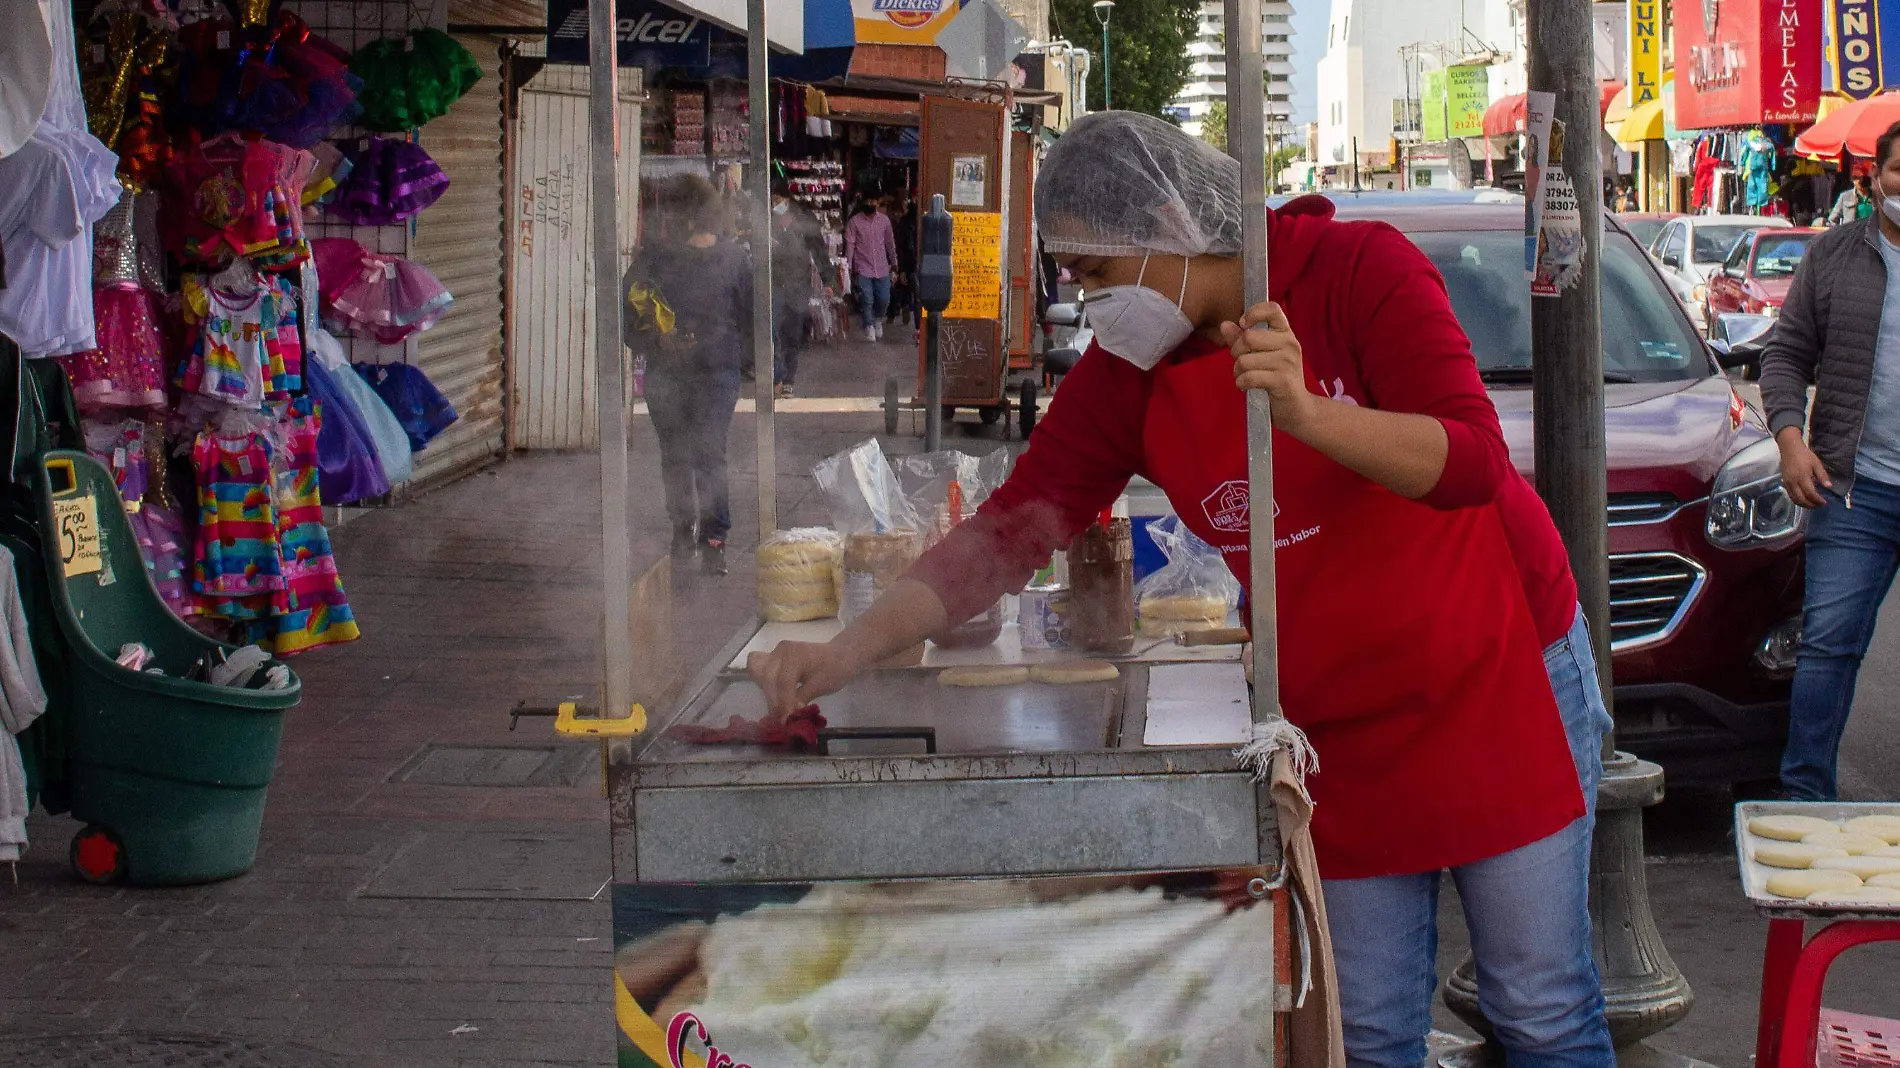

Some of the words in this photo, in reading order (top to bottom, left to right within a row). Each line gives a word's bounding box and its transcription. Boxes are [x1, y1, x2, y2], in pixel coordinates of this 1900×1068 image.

[880, 0, 938, 9] Dickies
[1636, 0, 1655, 53] UNI
[1843, 0, 1872, 90] ÑOS
[1545, 188, 1575, 198] 37942
[1291, 525, 1321, 544] Sabor
